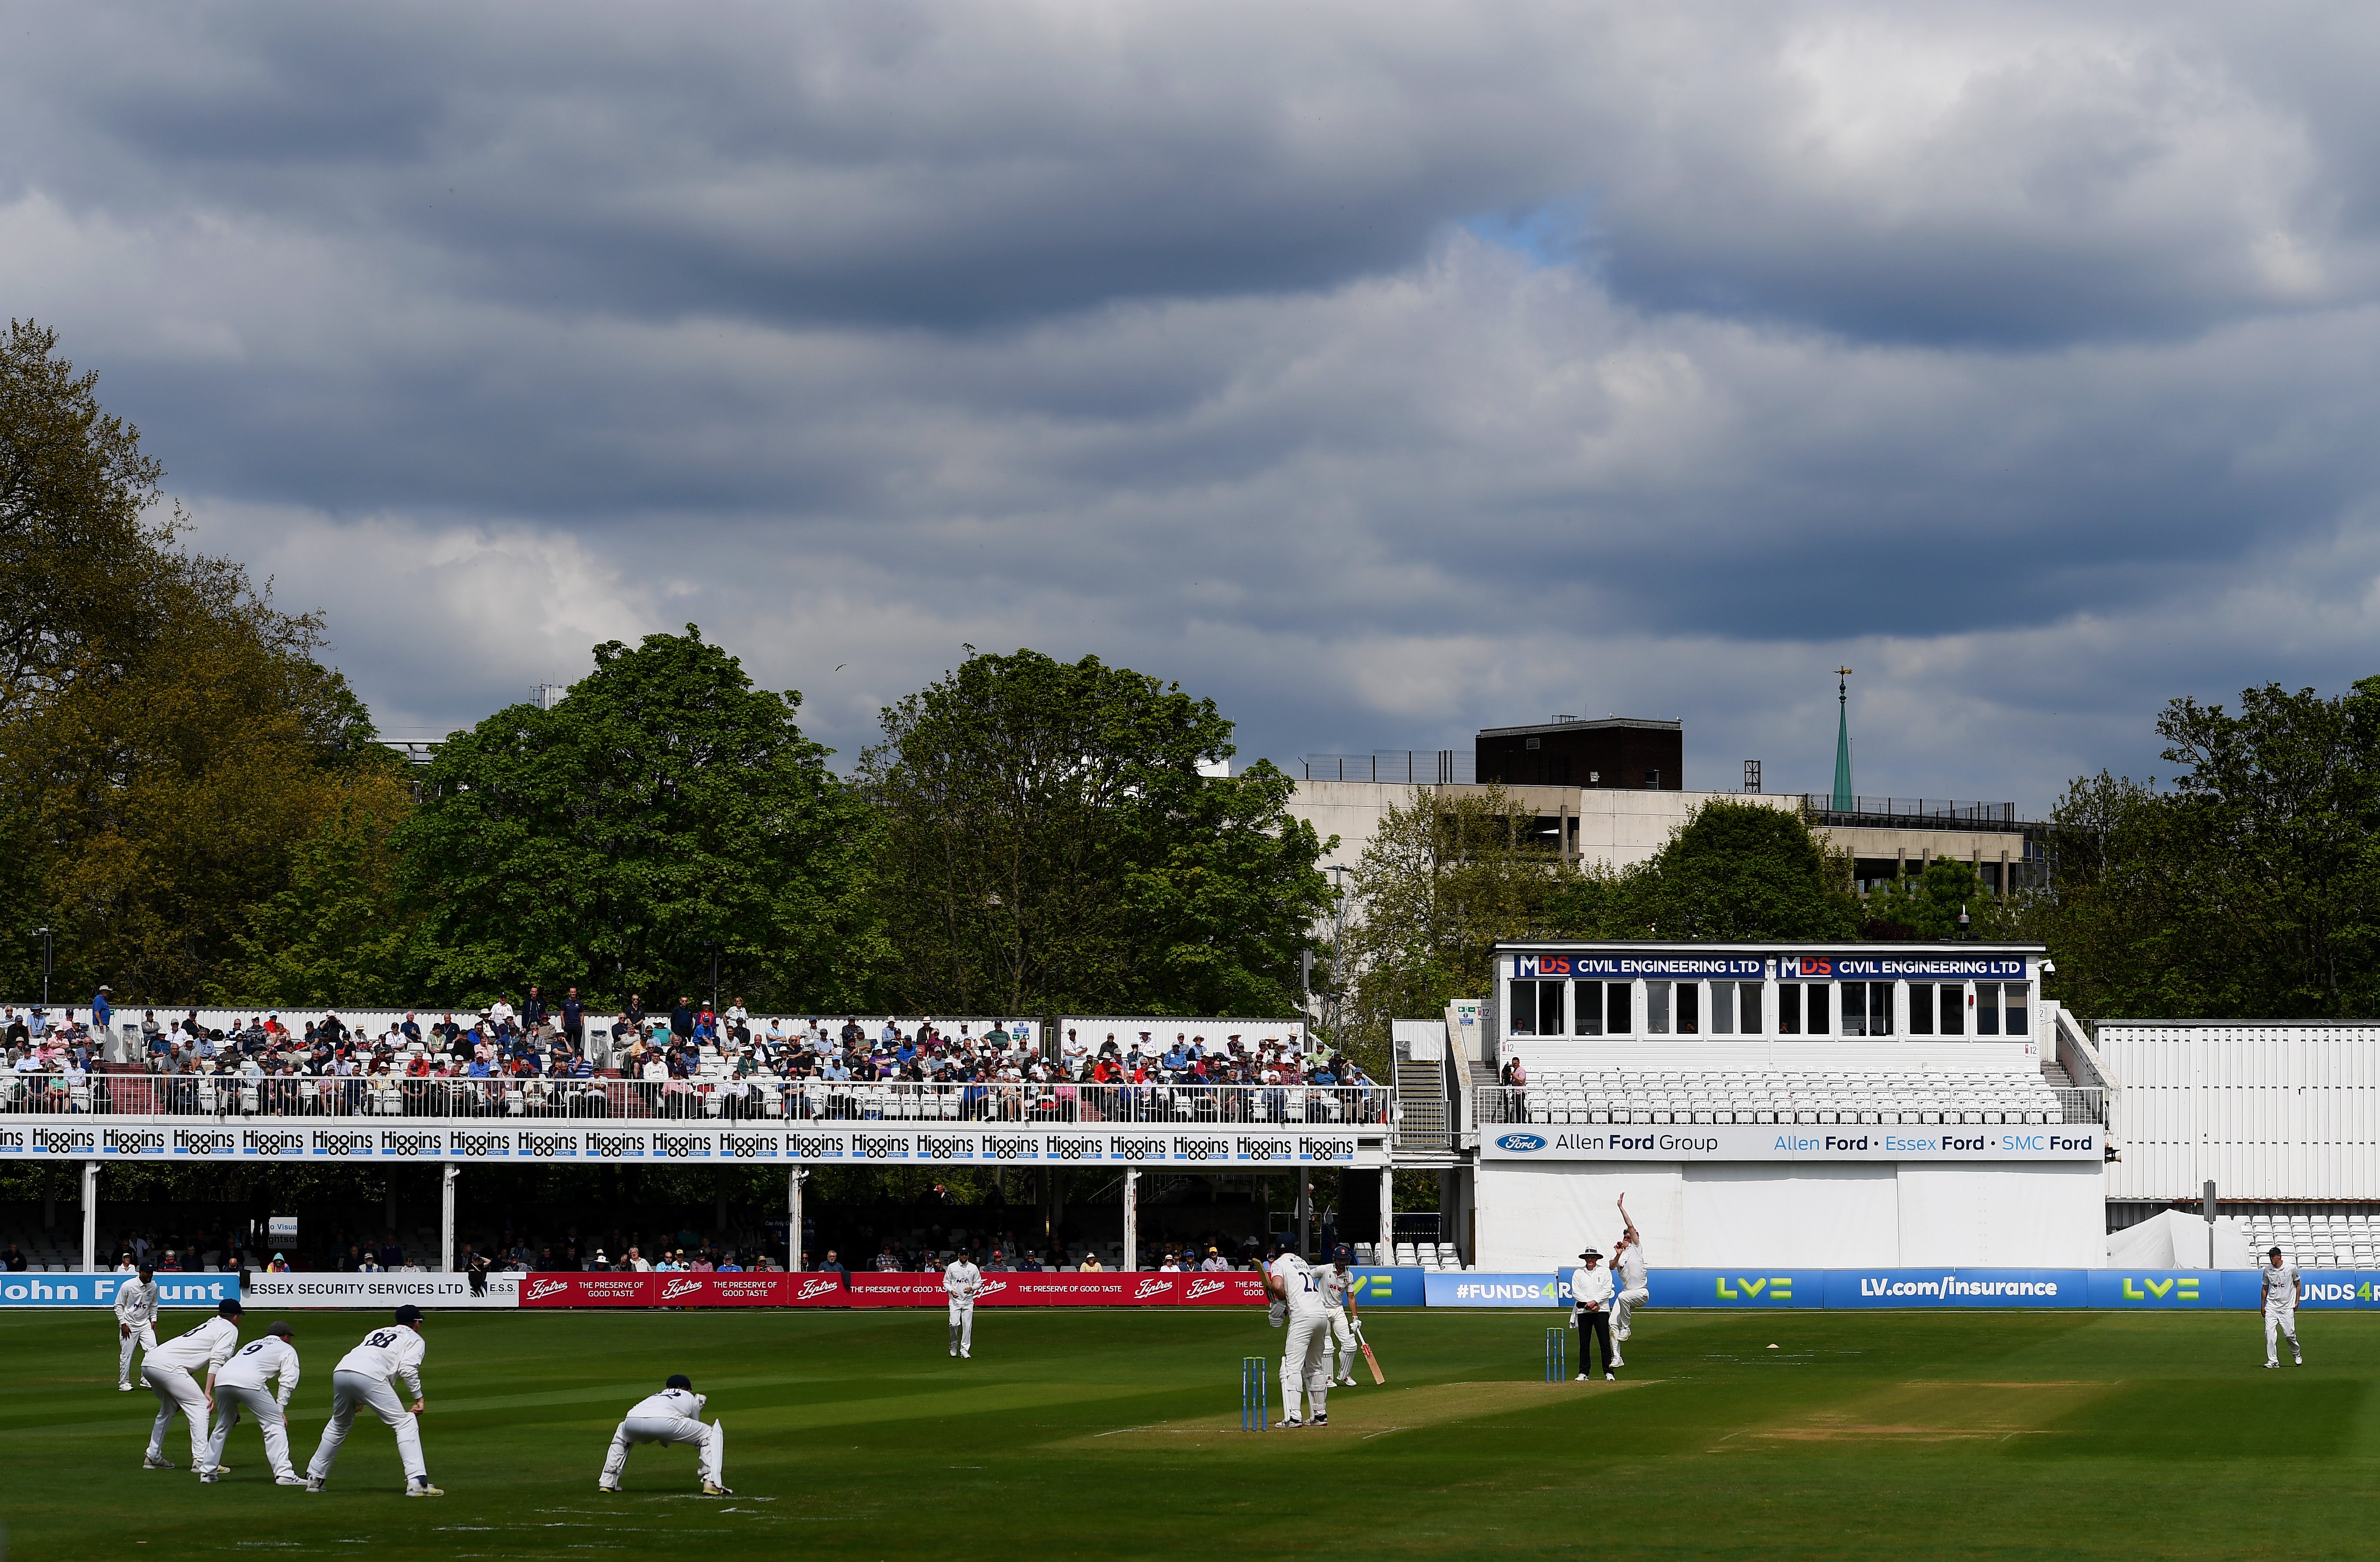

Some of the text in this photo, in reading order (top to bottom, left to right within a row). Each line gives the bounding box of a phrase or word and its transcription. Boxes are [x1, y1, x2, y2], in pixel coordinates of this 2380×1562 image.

[1520, 956, 1759, 977] MDS CIVIL ENGINEERING LTD
[1782, 957, 2020, 977] MDS CIVIL ENGINEERING LTD
[59, 1011, 63, 1019] 6
[1482, 1008, 1489, 1016] 12
[985, 1023, 989, 1031] 8
[1296, 1025, 1300, 1033] 9
[1507, 1044, 1514, 1052] 12
[2030, 1046, 2037, 1054] 12
[33, 1128, 94, 1153] Higgins
[104, 1129, 164, 1154] Higgins
[174, 1130, 234, 1154] Higgins
[244, 1131, 303, 1155] Higgins
[313, 1131, 372, 1155] Higgins
[382, 1131, 441, 1155] Higgins
[451, 1131, 509, 1156] Higgins
[519, 1132, 577, 1156] Higgins
[586, 1133, 644, 1157] Higgins
[653, 1133, 711, 1157] Higgins
[720, 1134, 777, 1157] Higgins
[787, 1134, 843, 1158] Higgins
[853, 1135, 909, 1158] Higgins
[917, 1135, 973, 1158] Higgins
[982, 1135, 1038, 1159] Higgins
[1047, 1136, 1102, 1159] Higgins
[1111, 1136, 1166, 1160] Higgins
[1174, 1137, 1228, 1160] Higgins
[1237, 1137, 1291, 1160] Higgins
[1300, 1138, 1353, 1160] Higgins
[1505, 1135, 1537, 1150] Ford
[1556, 1134, 1717, 1153] Allen Ford Group
[1774, 1135, 2091, 1151] Allen Ford Essex Ford SMC Ford
[268, 1235, 296, 1245] ghtso
[153, 1280, 223, 1300] unt
[251, 1283, 463, 1294] ESSEX SECURITY SERVICES LTD
[490, 1284, 515, 1292] E.S.S.
[526, 1279, 568, 1300] Tiptree
[661, 1279, 702, 1299] Tiptree
[797, 1279, 837, 1299] Tiptree
[1134, 1278, 1173, 1299] Tiptree
[1186, 1278, 1225, 1299] Tiptree
[1861, 1276, 2057, 1300] LV.com/insurance
[243, 1344, 263, 1355] 9
[364, 1332, 397, 1348] 88
